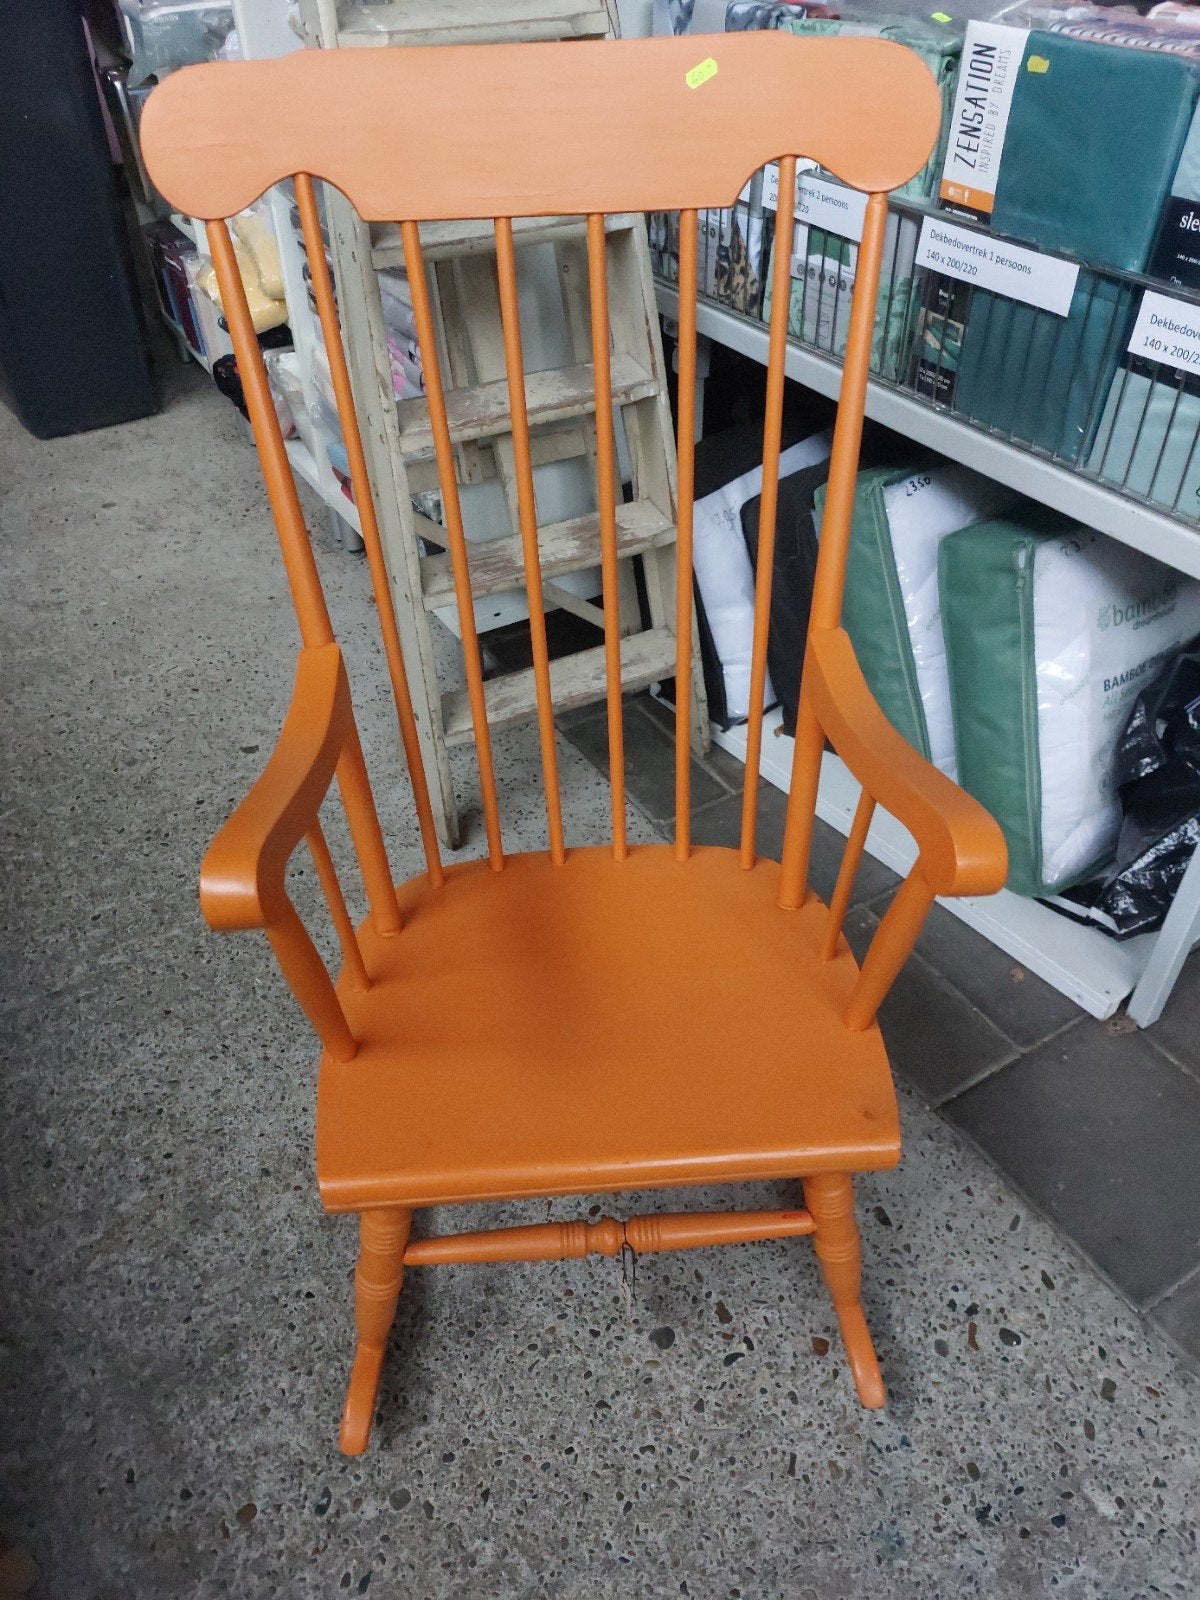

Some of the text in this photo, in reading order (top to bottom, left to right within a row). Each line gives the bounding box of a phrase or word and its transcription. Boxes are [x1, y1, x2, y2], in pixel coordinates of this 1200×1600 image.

[953, 42, 997, 170] ZENSATION
[978, 49, 1011, 173] INSPIRED BY DREAMS
[821, 192, 849, 210] persoons
[1180, 211, 1200, 233] sle
[926, 249, 940, 262] 140
[946, 256, 978, 276] 200/220
[930, 229, 1032, 275] Dekbedovertrek 1 persoons
[1142, 336, 1200, 365] 140 x 200/2
